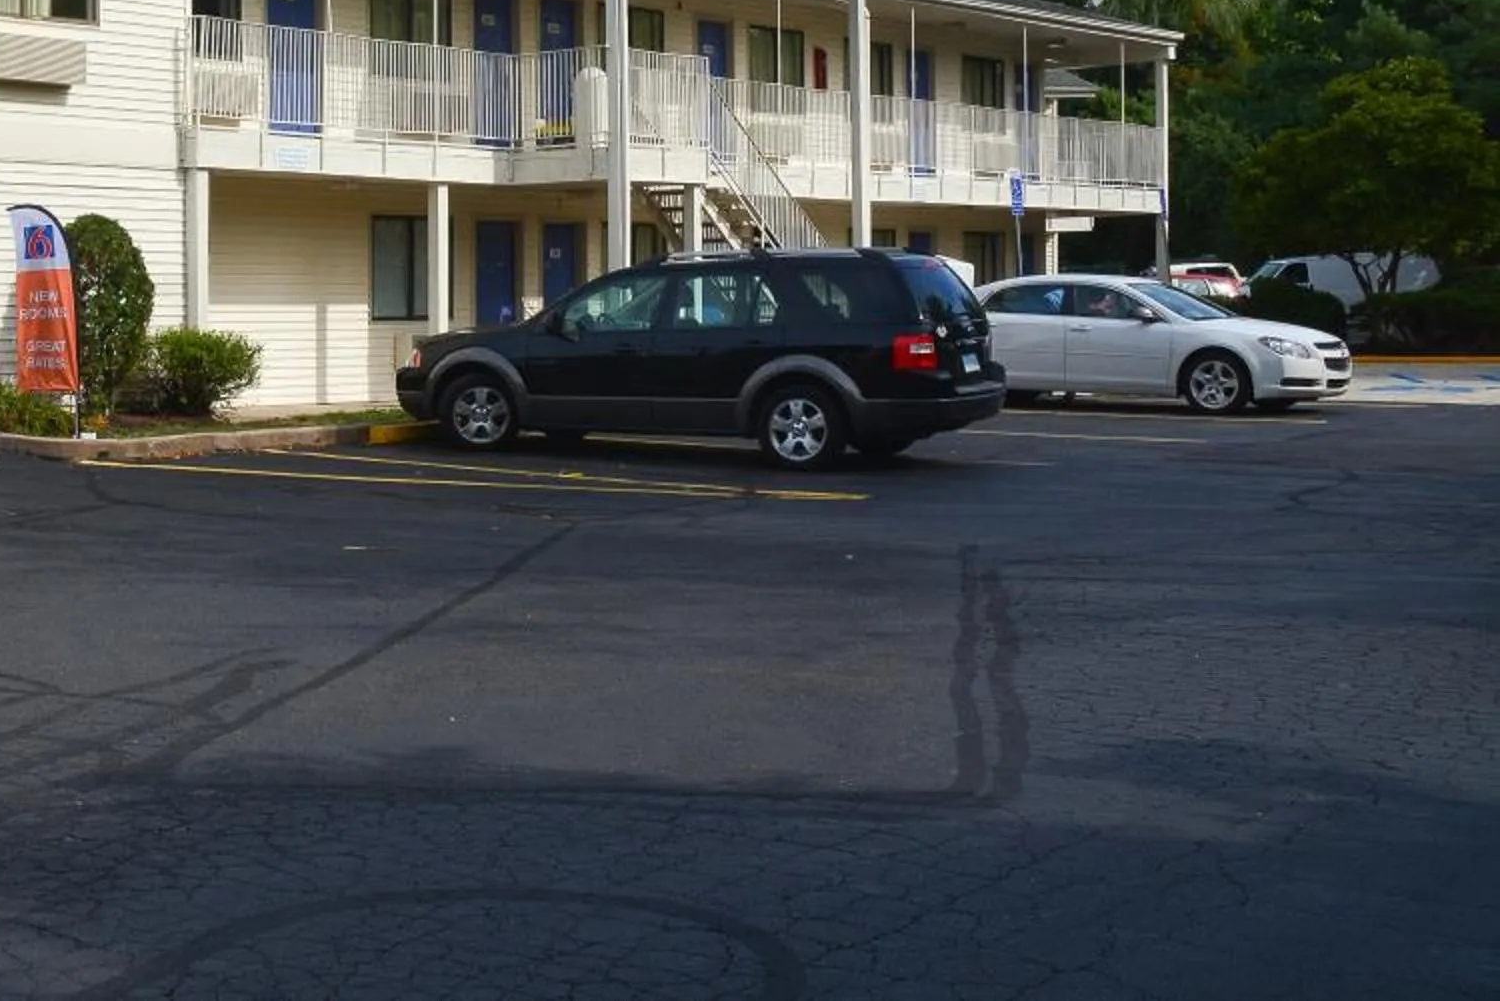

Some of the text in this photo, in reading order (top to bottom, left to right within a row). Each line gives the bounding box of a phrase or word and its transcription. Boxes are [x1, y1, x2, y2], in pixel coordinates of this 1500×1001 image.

[28, 225, 53, 261] 6
[29, 289, 59, 304] NEW
[26, 339, 67, 353] GREAT
